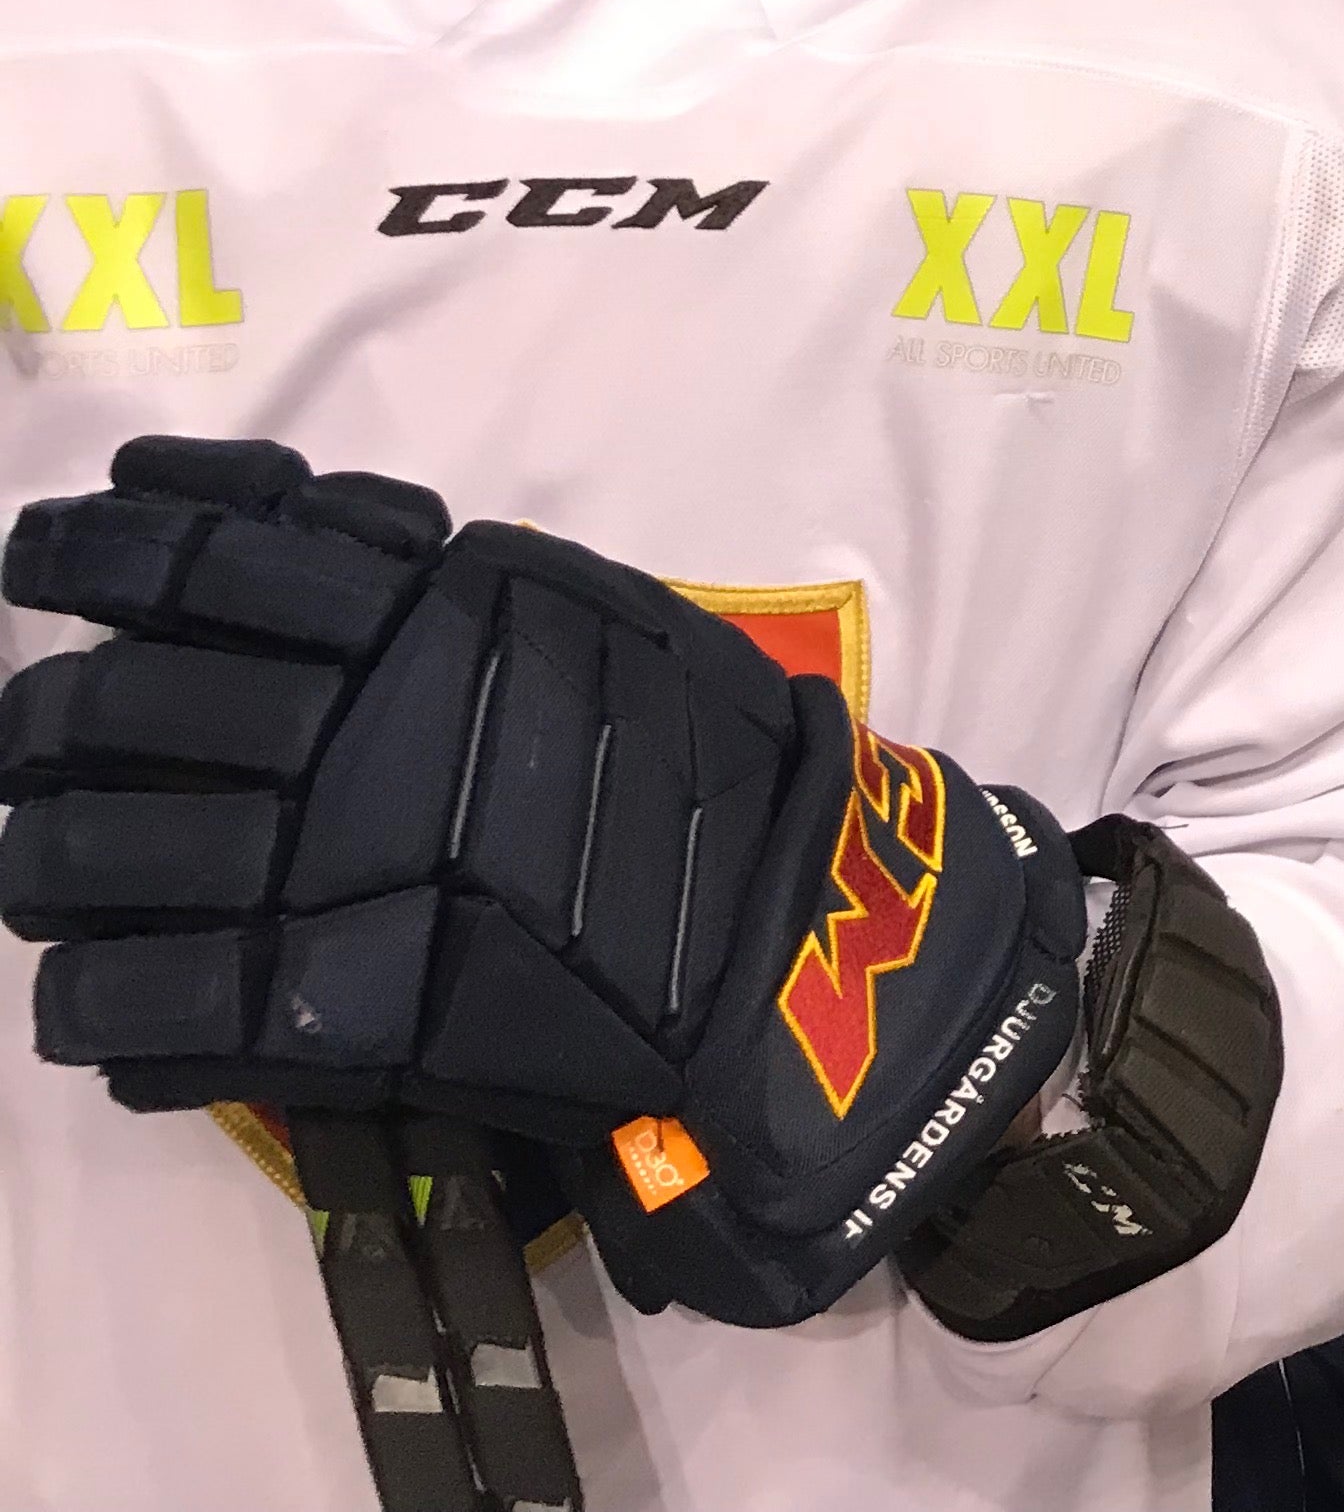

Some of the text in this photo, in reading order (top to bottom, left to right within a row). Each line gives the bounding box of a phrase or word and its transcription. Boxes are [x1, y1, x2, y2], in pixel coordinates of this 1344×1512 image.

[377, 176, 770, 237] CCM
[891, 188, 1135, 343] XXL
[935, 340, 1028, 377] SPORTS
[869, 982, 1057, 1209] DJURGÅRDENS
